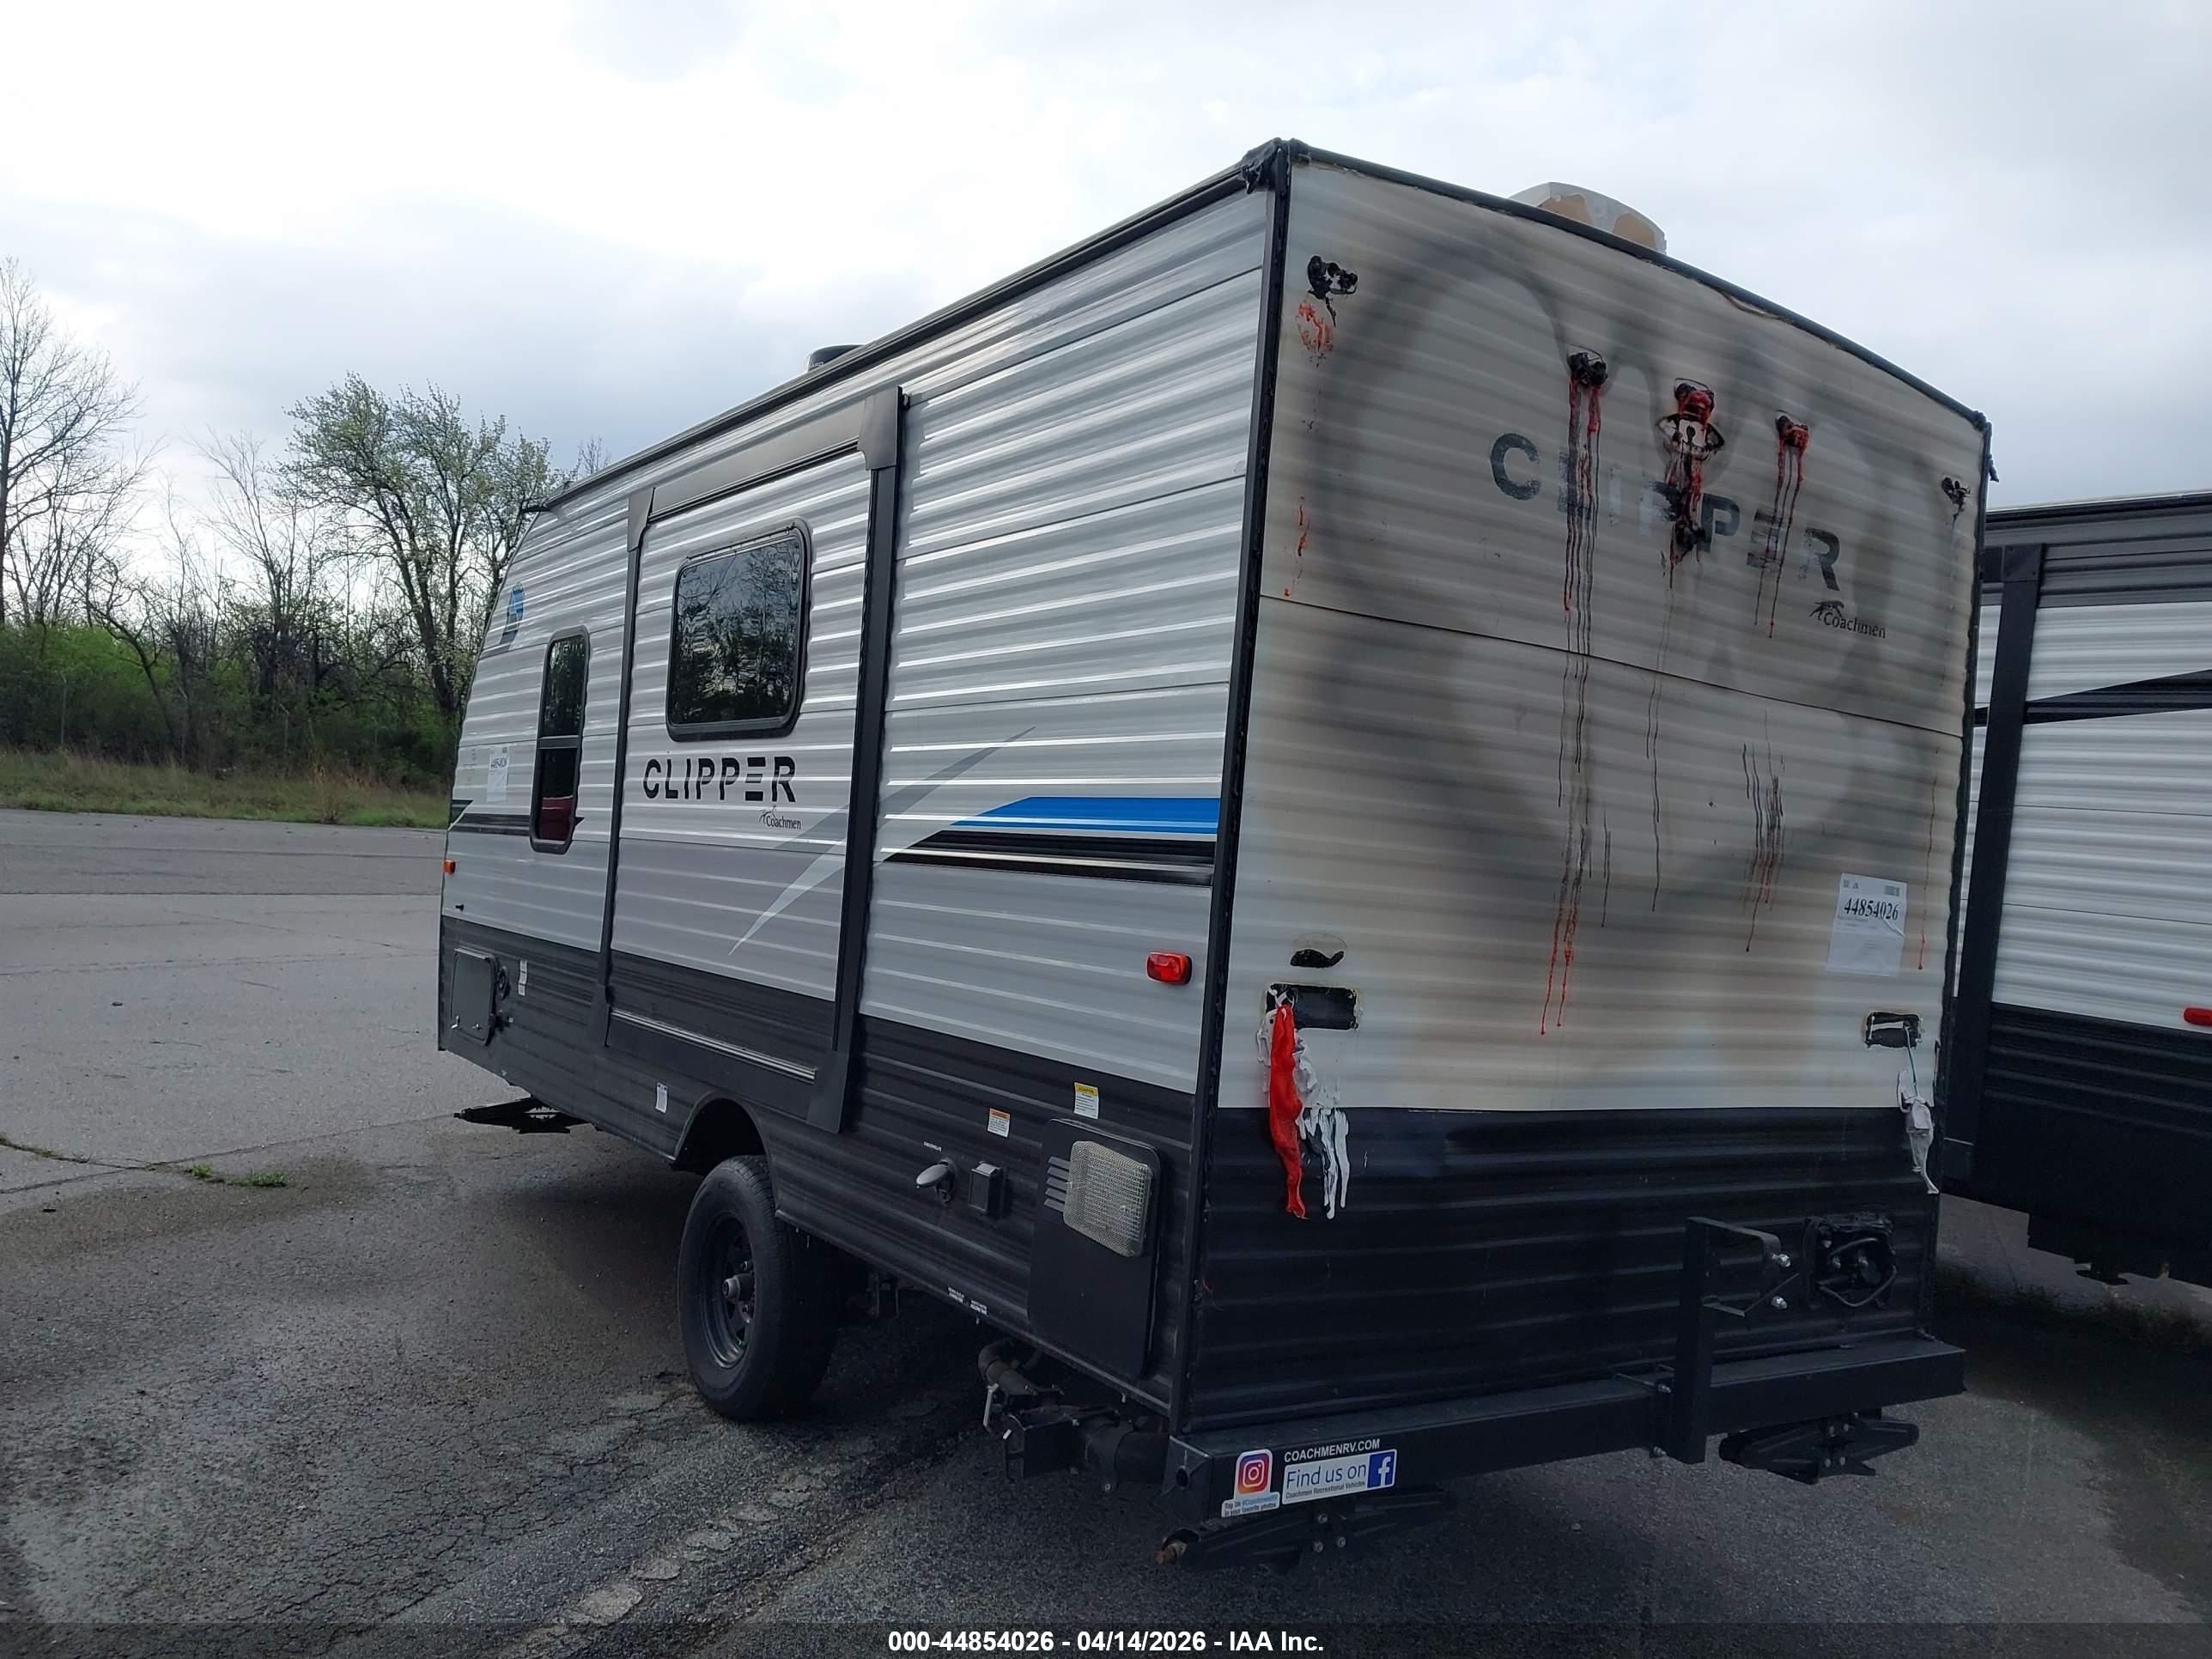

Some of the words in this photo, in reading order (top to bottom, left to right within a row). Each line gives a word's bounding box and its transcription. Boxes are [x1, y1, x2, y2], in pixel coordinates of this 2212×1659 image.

[1822, 611, 1887, 640] Coachmen
[642, 756, 796, 803] CLIPPER
[766, 814, 802, 830] Coachmen
[1844, 897, 1899, 921] 44854026
[1284, 1439, 1380, 1462] COACHMENRV.COM
[1286, 1466, 1322, 1490] Find
[1325, 1467, 1343, 1483] us
[1347, 1463, 1367, 1480] on
